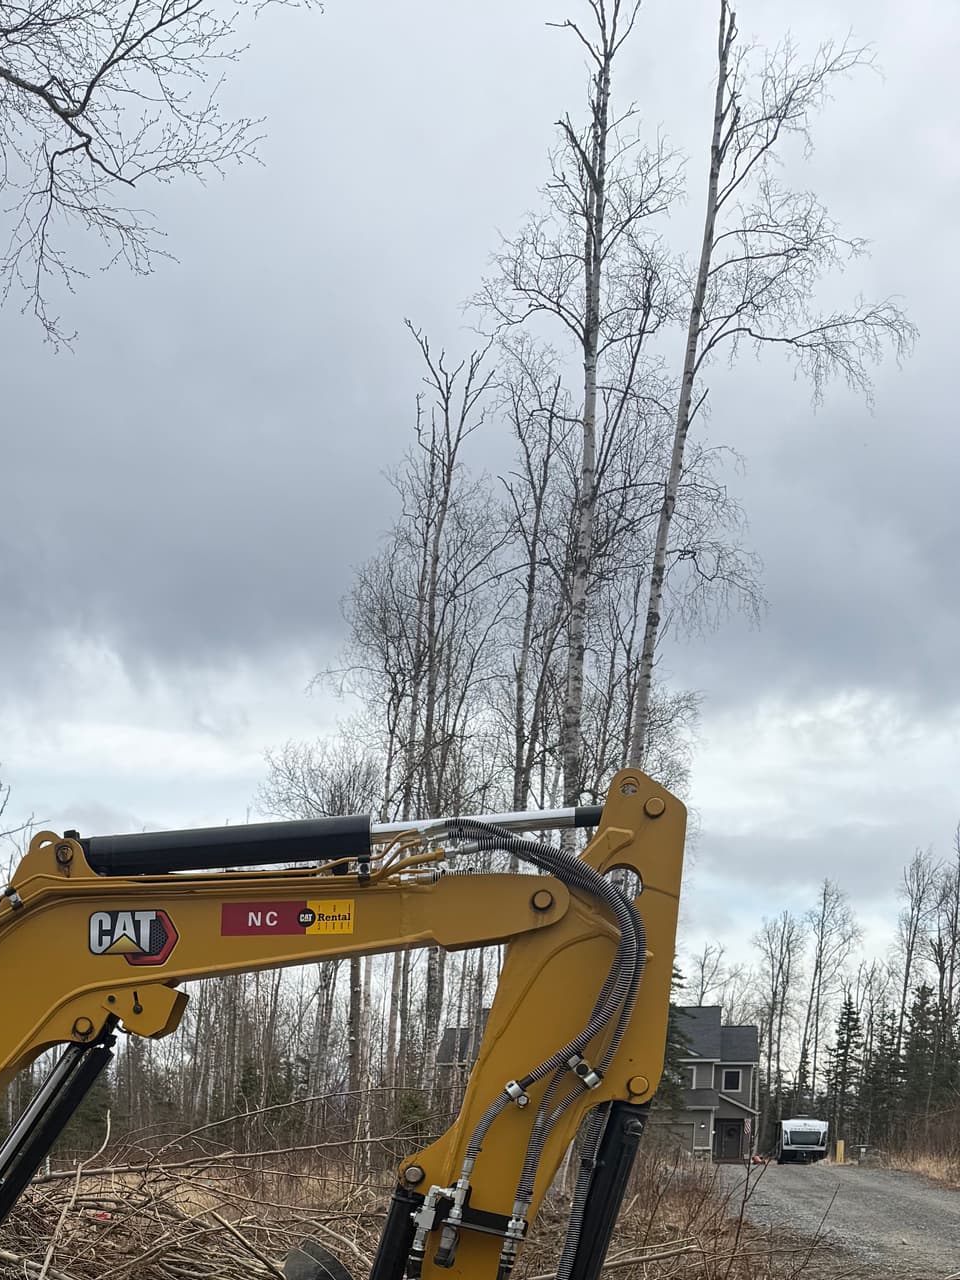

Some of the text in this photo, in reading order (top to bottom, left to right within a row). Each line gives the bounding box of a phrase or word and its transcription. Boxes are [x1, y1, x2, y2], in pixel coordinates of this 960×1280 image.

[90, 911, 156, 954] CAT
[248, 911, 351, 927] NC CAT Rental
